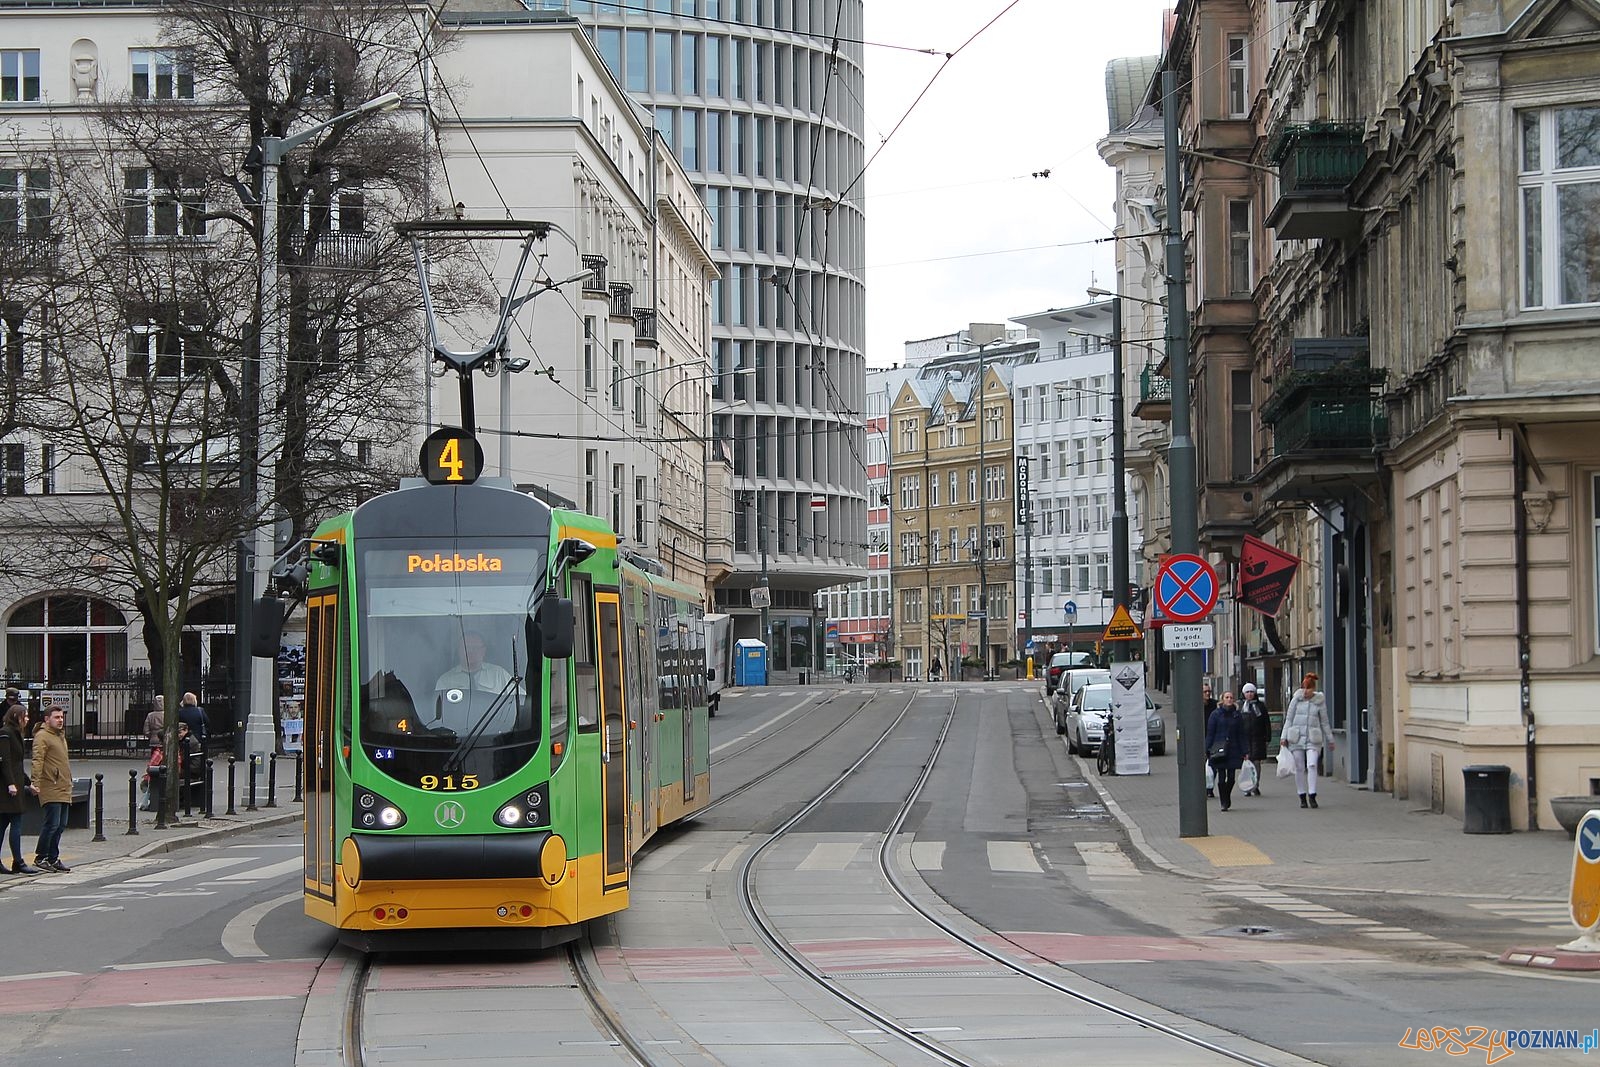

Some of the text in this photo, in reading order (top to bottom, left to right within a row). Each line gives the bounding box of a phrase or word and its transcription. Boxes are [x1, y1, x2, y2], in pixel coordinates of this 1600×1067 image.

[439, 438, 463, 481] 4
[1018, 458, 1027, 522] McDonalds
[407, 553, 502, 572] Połabska
[397, 719, 407, 732] 4
[420, 774, 479, 790] 915
